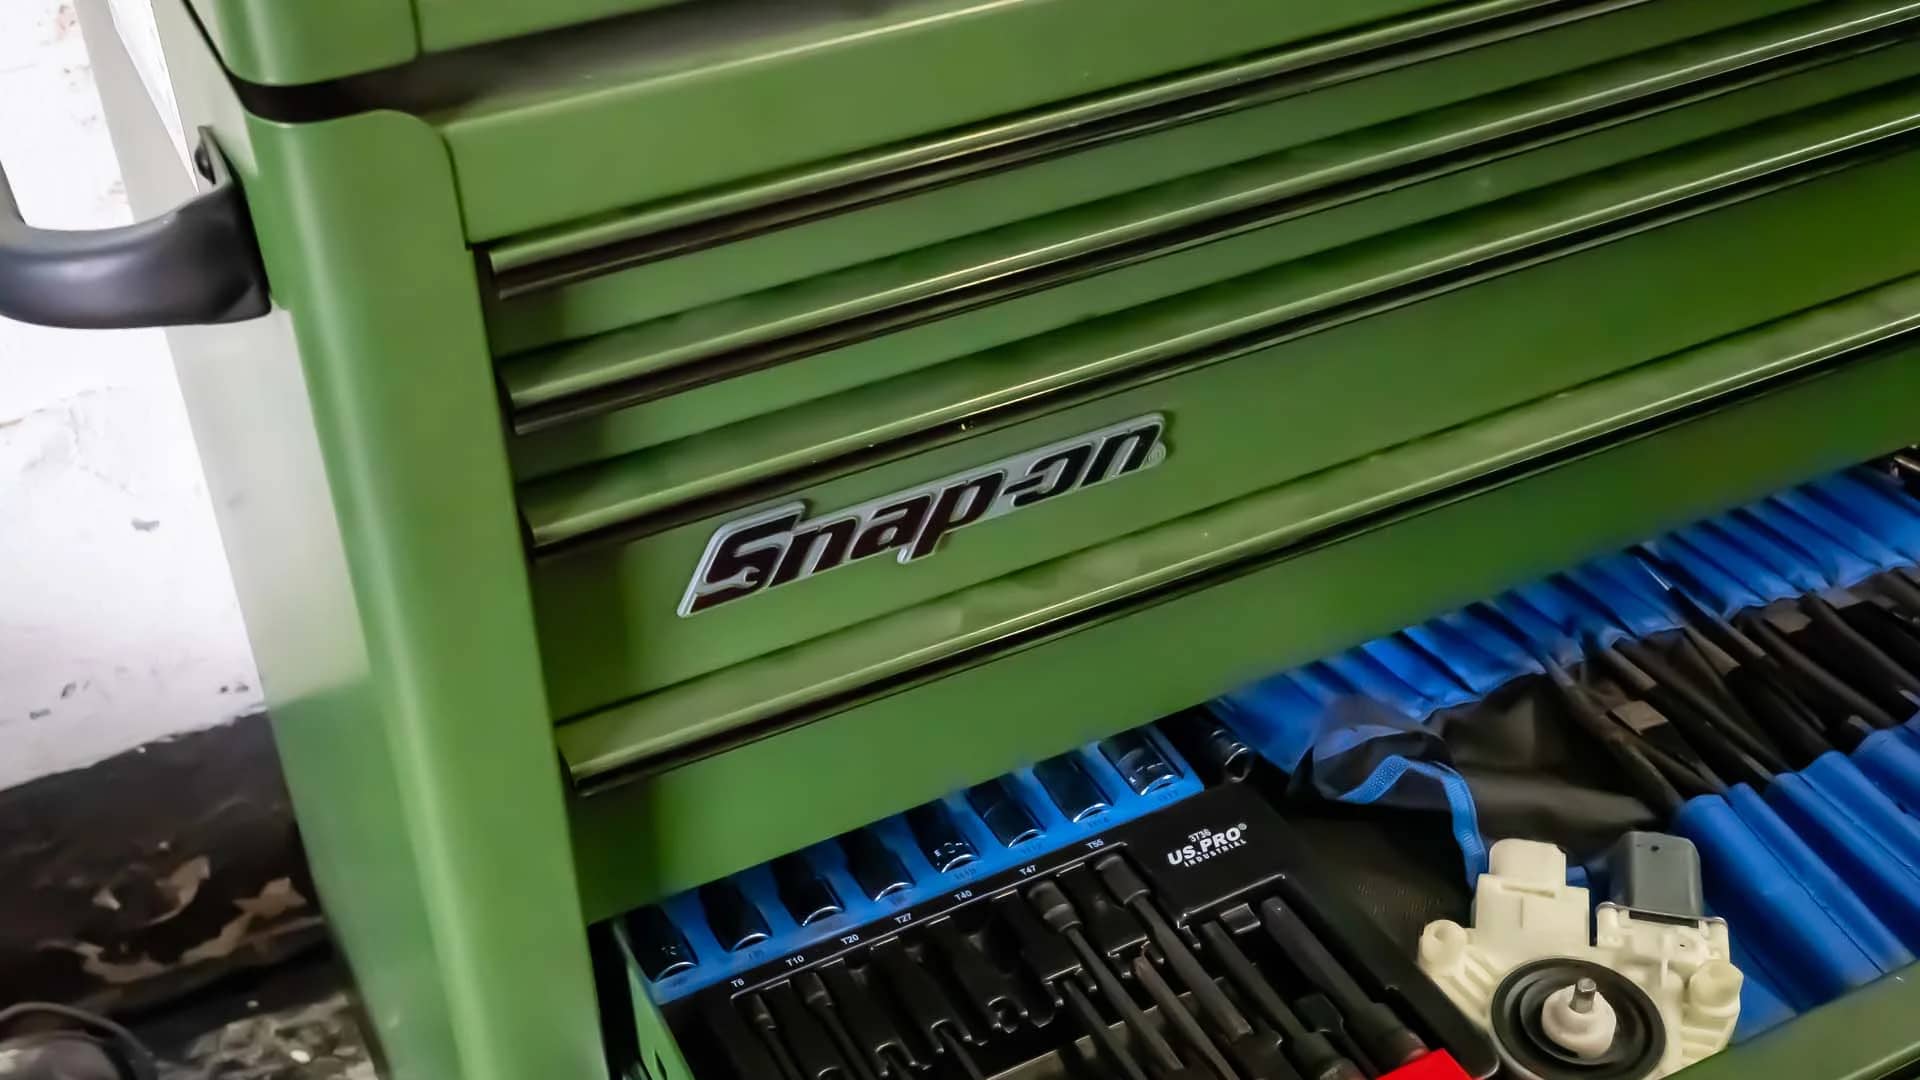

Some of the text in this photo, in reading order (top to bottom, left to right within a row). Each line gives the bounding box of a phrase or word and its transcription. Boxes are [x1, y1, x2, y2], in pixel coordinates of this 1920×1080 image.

[682, 419, 1162, 616] Snap-on
[1184, 838, 1247, 867] INDUSTRIAL
[785, 954, 804, 967] T10
[841, 934, 859, 945] T20
[894, 912, 911, 924] T27
[954, 890, 972, 901] T40
[1019, 864, 1036, 876] T47
